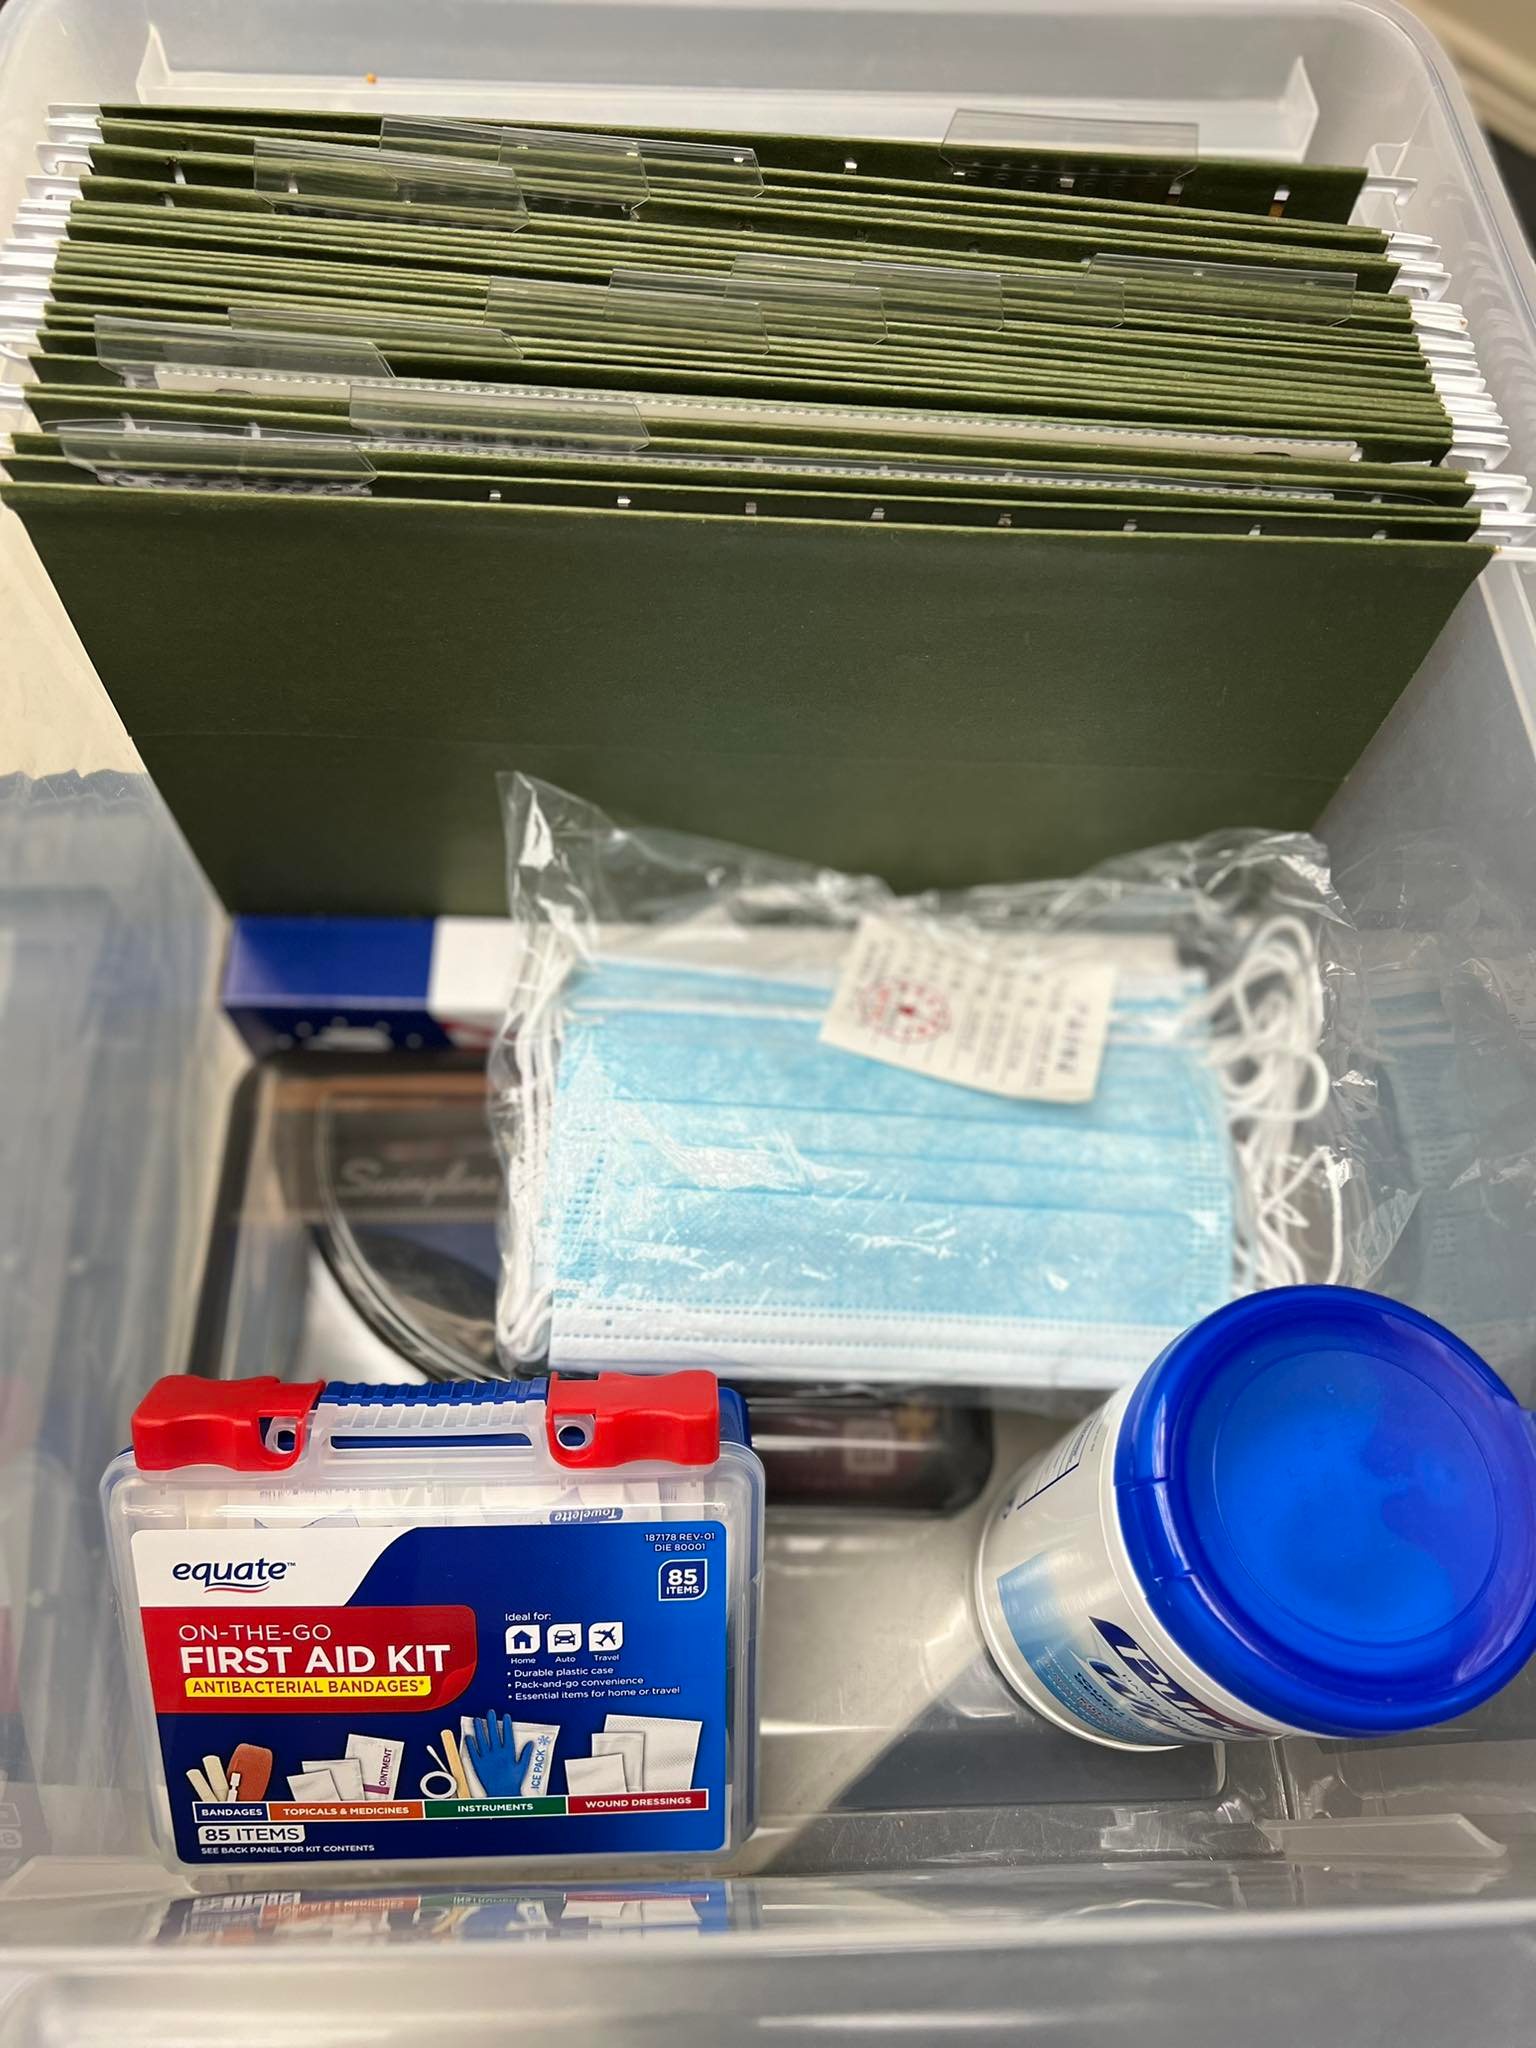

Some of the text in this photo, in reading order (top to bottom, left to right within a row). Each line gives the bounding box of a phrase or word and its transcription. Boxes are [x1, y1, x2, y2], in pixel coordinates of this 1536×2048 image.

[554, 1507, 619, 1522] Towelette
[645, 1532, 715, 1542] 187178 REV-01
[654, 1543, 706, 1552] DIE 80001
[668, 1568, 698, 1586] 85
[666, 1585, 700, 1595] ITEMS
[504, 1611, 552, 1621] Ideal for:
[178, 1624, 332, 1641] ON-THE-GO
[179, 1644, 451, 1674] FIRST AID KIT
[510, 1657, 536, 1665] Home
[554, 1655, 577, 1664] Auto
[594, 1653, 620, 1662] Travel
[513, 1667, 614, 1678] Durable plastic case
[192, 1680, 324, 1694] ANTIBACTERIAL
[514, 1677, 644, 1690] Pack-and-go convenience
[515, 1686, 681, 1701] Essential items for home or travel
[378, 1747, 393, 1787] OINTMENT
[531, 1749, 546, 1790] ICE PACK
[457, 1803, 534, 1813] INSTRUMENTS
[585, 1797, 692, 1809] WOUND DRESSINGS
[201, 1807, 263, 1817] BANDAGES
[282, 1806, 410, 1816] TOPICALS & MEDICINES
[204, 1828, 300, 1841] 85 ITEMS
[201, 1844, 375, 1855] SEE BACK PANEL FOR KIT CONTENTS
